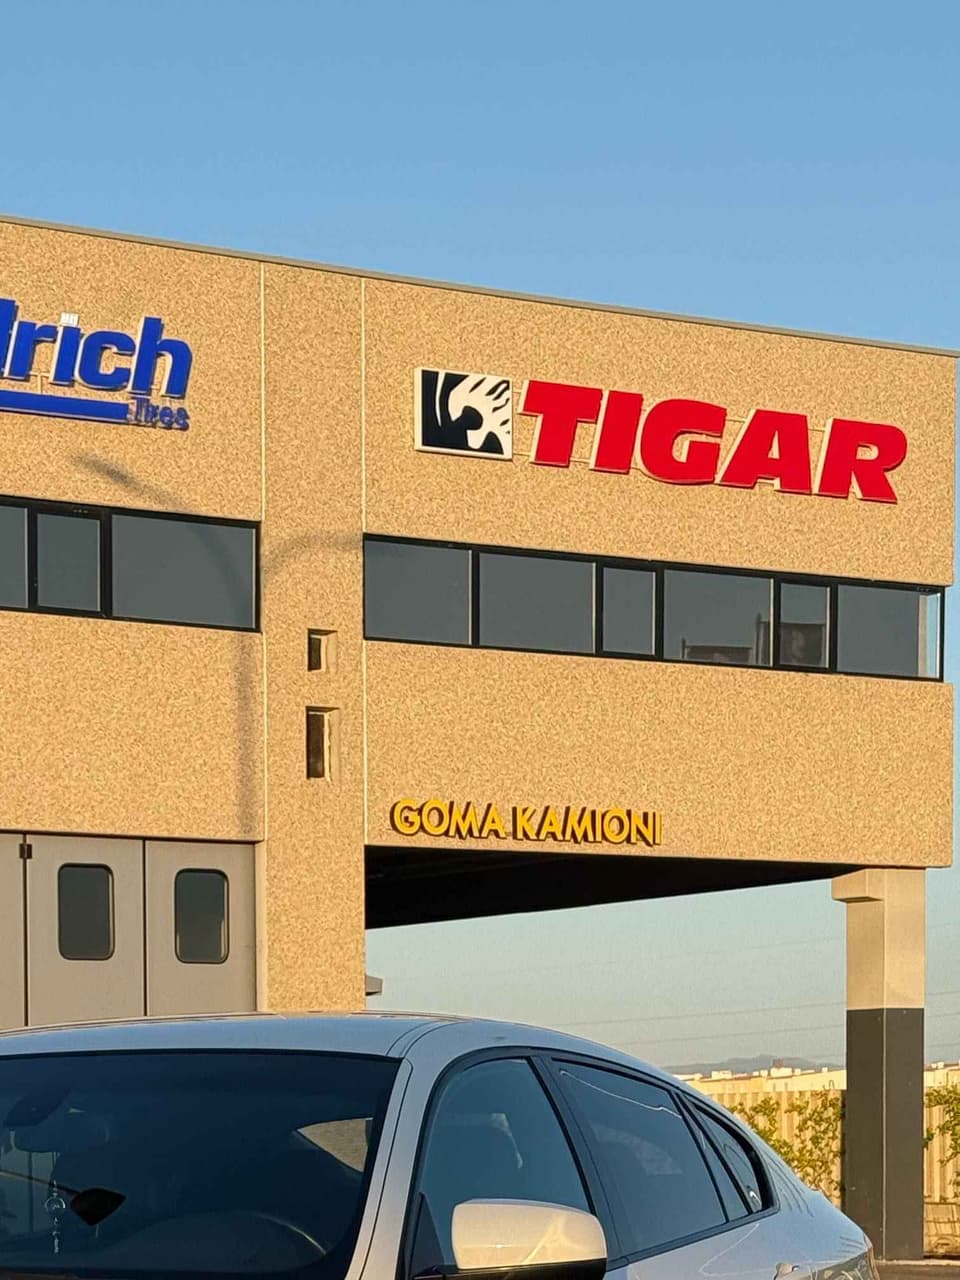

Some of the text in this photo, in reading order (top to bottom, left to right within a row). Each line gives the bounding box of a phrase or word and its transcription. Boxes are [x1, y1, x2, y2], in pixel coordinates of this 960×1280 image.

[517, 379, 908, 503] TIGAR
[391, 798, 662, 847] GOMA KAMIONI
